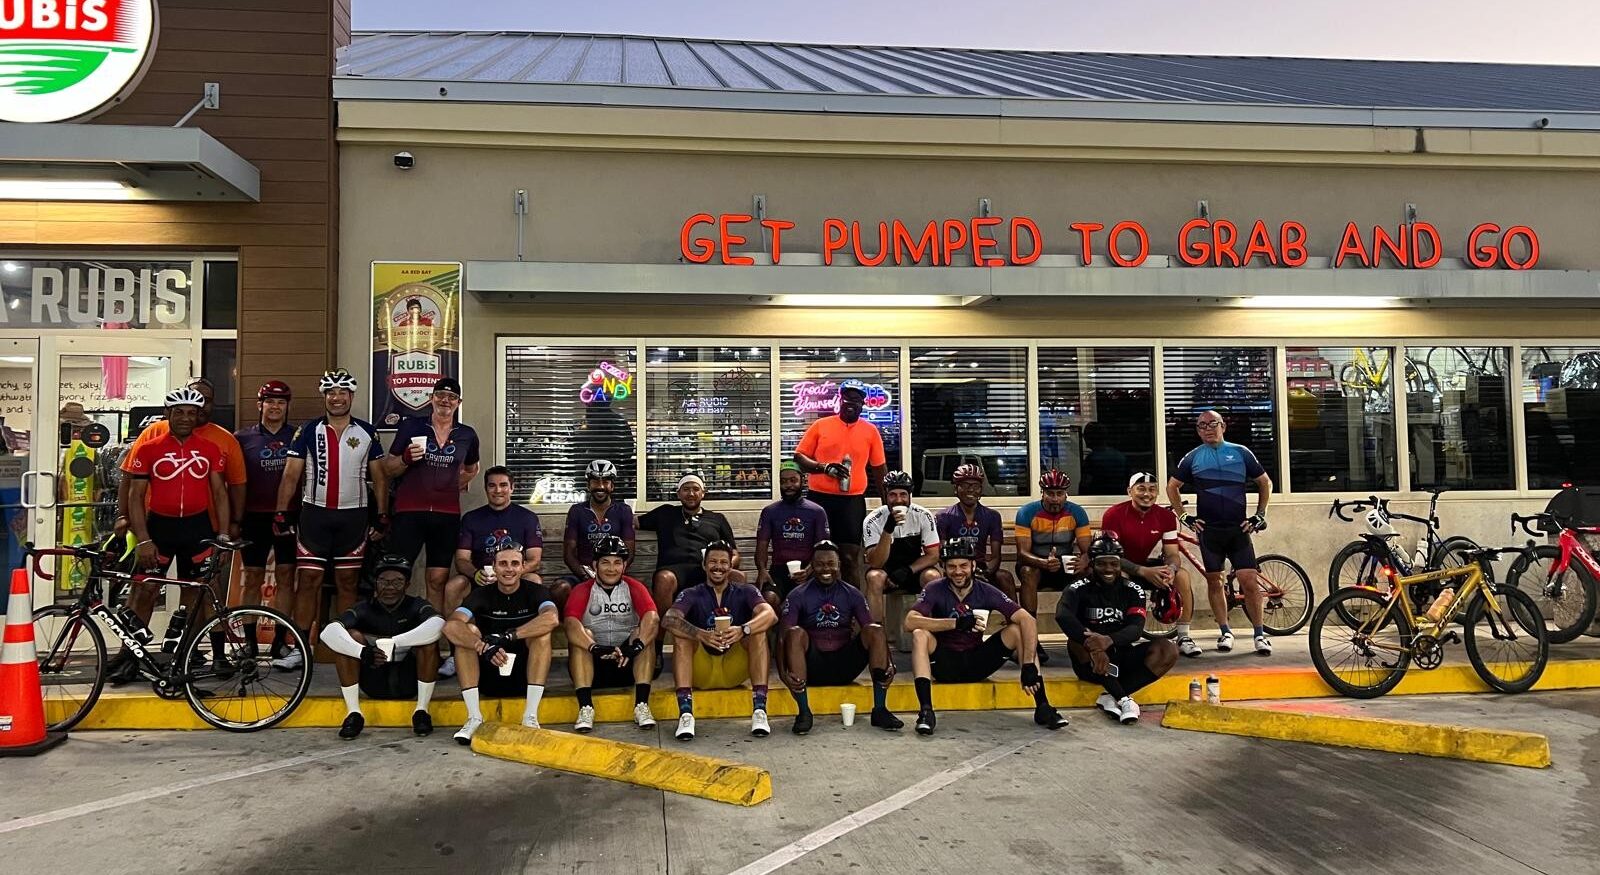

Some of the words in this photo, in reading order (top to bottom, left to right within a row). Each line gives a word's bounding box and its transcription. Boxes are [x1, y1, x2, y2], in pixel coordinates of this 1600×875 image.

[0, 0, 108, 31] UBiS
[681, 213, 795, 264] GET
[823, 217, 1042, 266] PUMPED
[1070, 221, 1149, 267] TO
[1178, 219, 1308, 268] GRAB
[1336, 221, 1442, 268] AND
[1467, 223, 1540, 270] GO
[31, 268, 186, 323] RUBIS
[397, 360, 436, 370] RUBiS
[580, 374, 633, 403] CANDY
[793, 380, 836, 398] Treat
[793, 394, 841, 416] Yourself
[261, 459, 286, 467] CAYM
[318, 433, 328, 487] FRANCE
[424, 453, 454, 463] CAYMAN
[552, 480, 574, 491] ICE
[542, 491, 586, 503] CREAM
